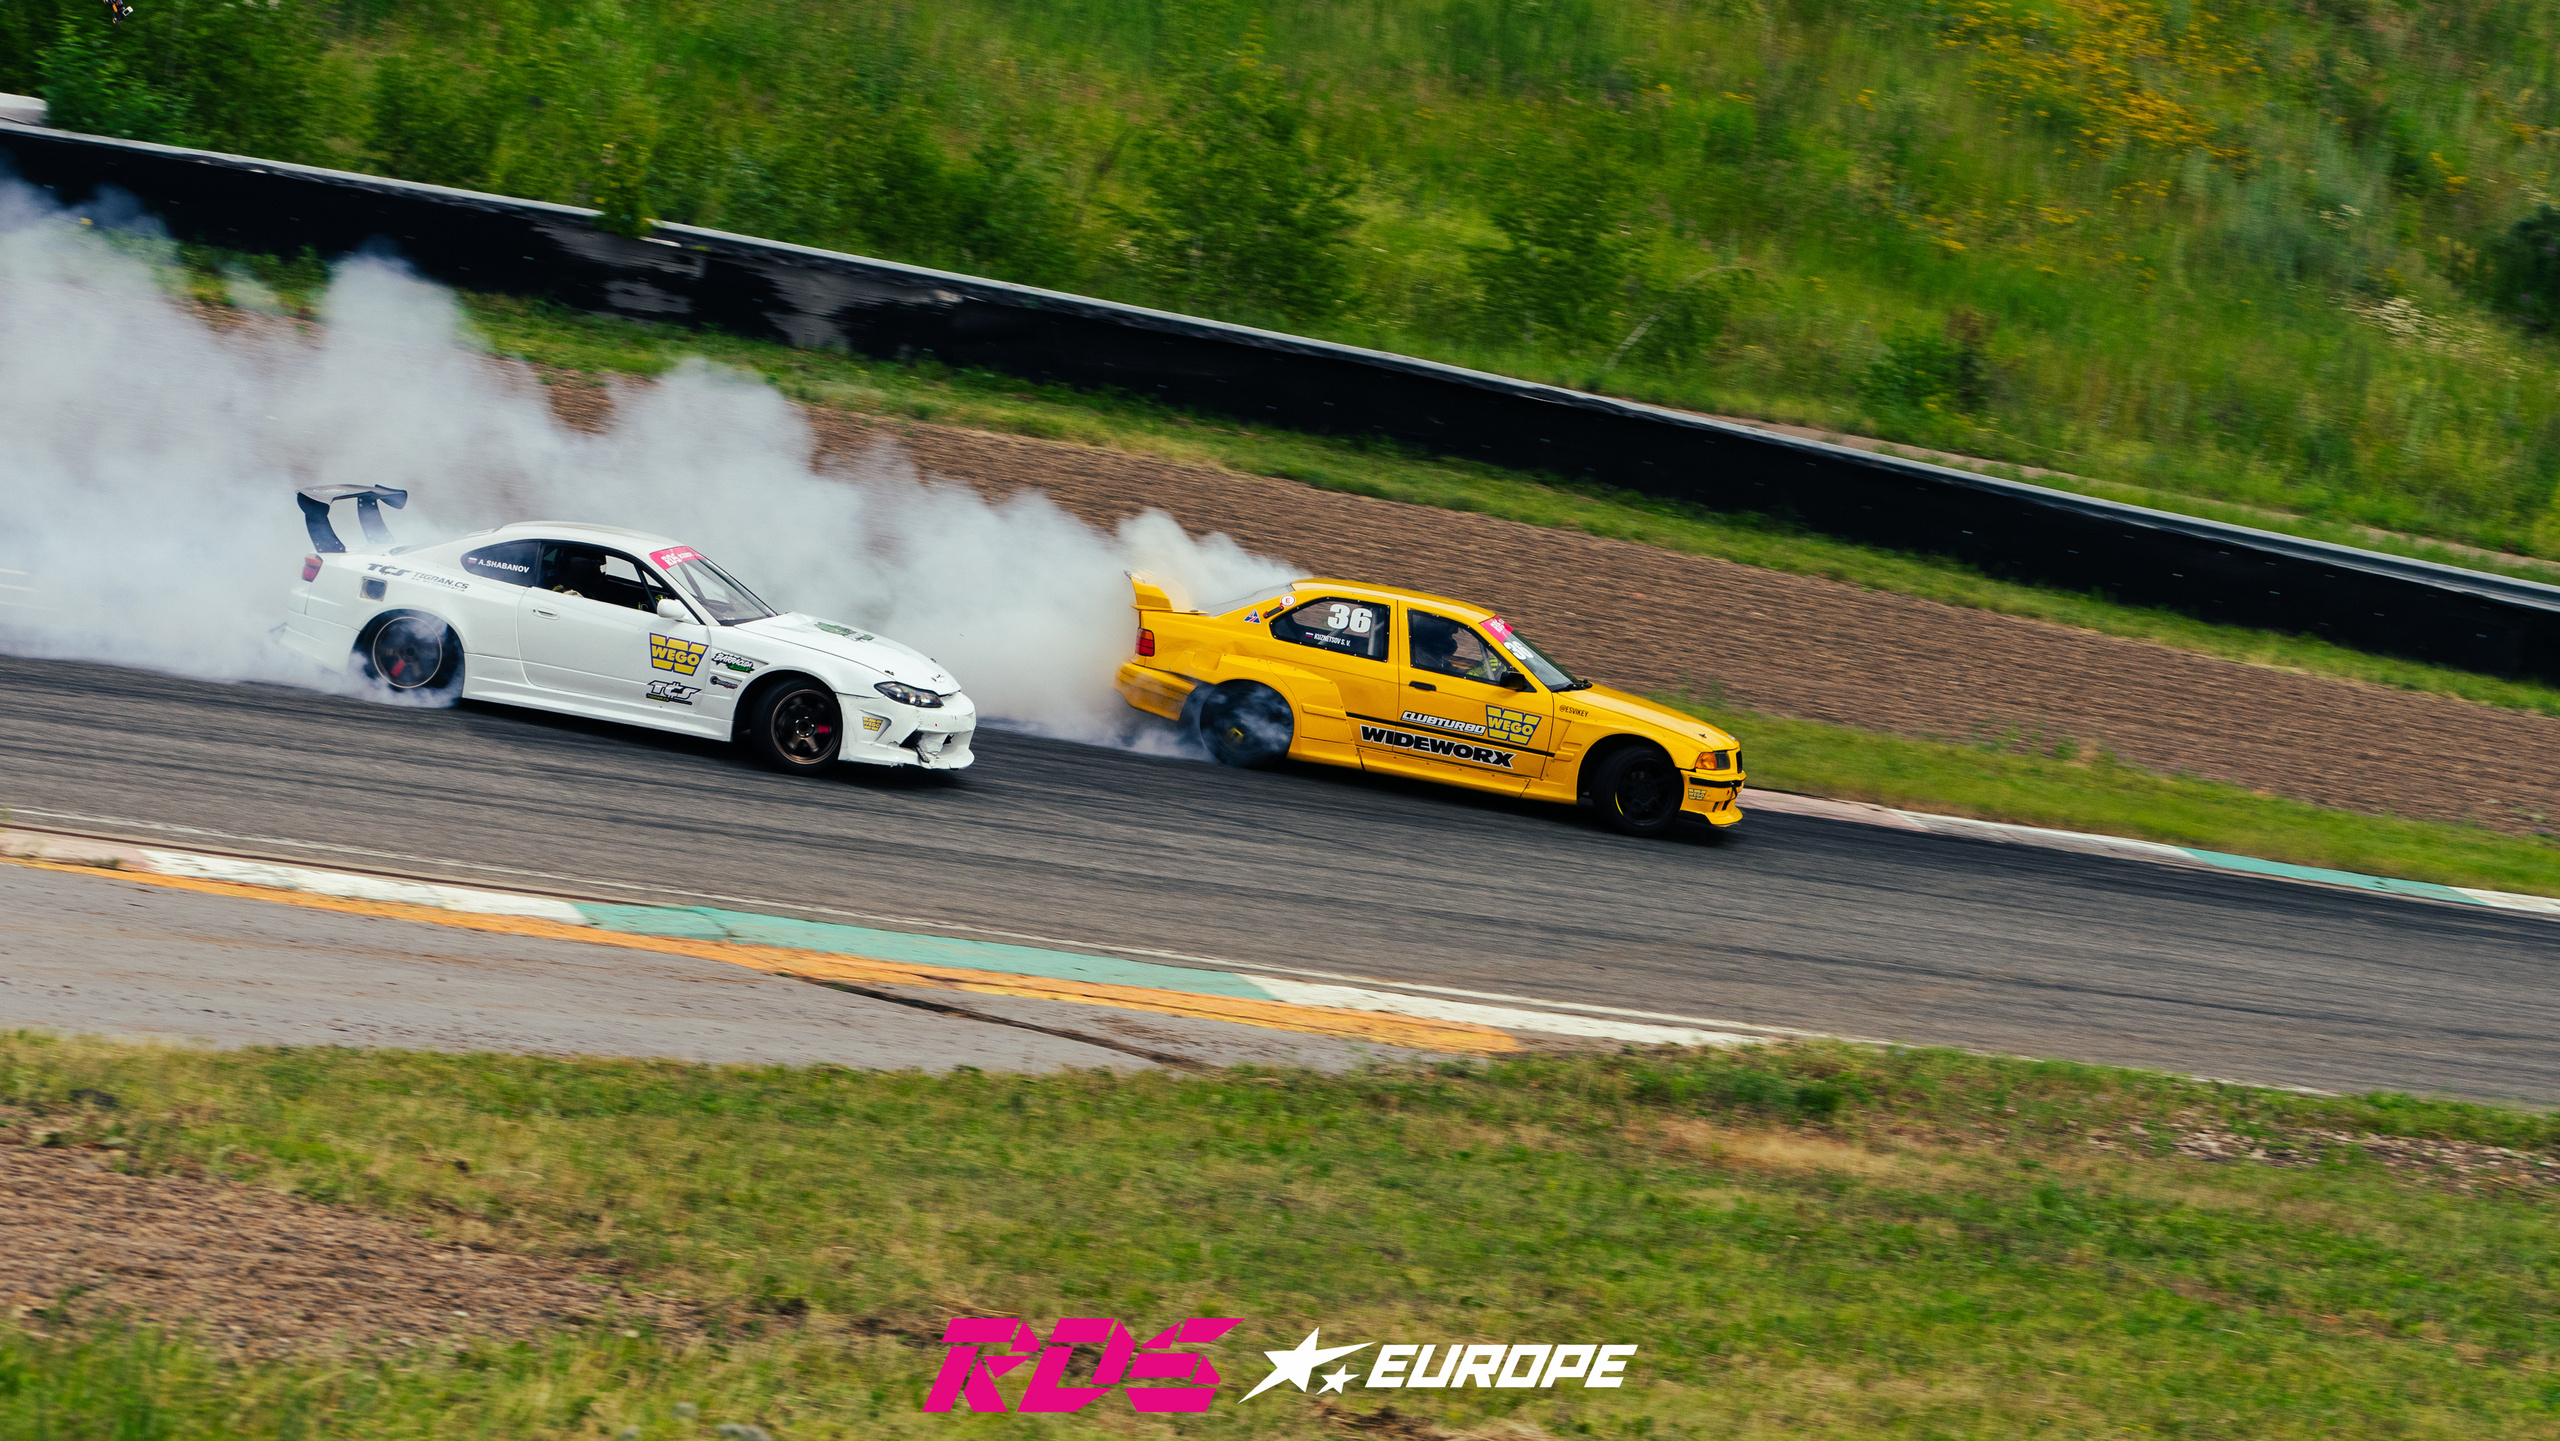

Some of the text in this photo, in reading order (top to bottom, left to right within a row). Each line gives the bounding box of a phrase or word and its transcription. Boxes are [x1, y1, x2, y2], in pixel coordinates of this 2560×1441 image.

[367, 562, 413, 577] TCS
[478, 559, 530, 573] A.SHABANOV
[413, 572, 470, 590] TIGRAN.CS
[1327, 603, 1373, 633] 36
[1313, 633, 1341, 645] KUZNETSOV
[651, 644, 700, 666] WEGO
[1503, 640, 1534, 660] 36
[647, 680, 703, 700] TCS
[1559, 704, 1589, 718] @ESVIKEY
[1401, 710, 1487, 736] CLUBTURBO
[1487, 716, 1535, 736] WEGO
[1359, 724, 1517, 770] WIDEWORX
